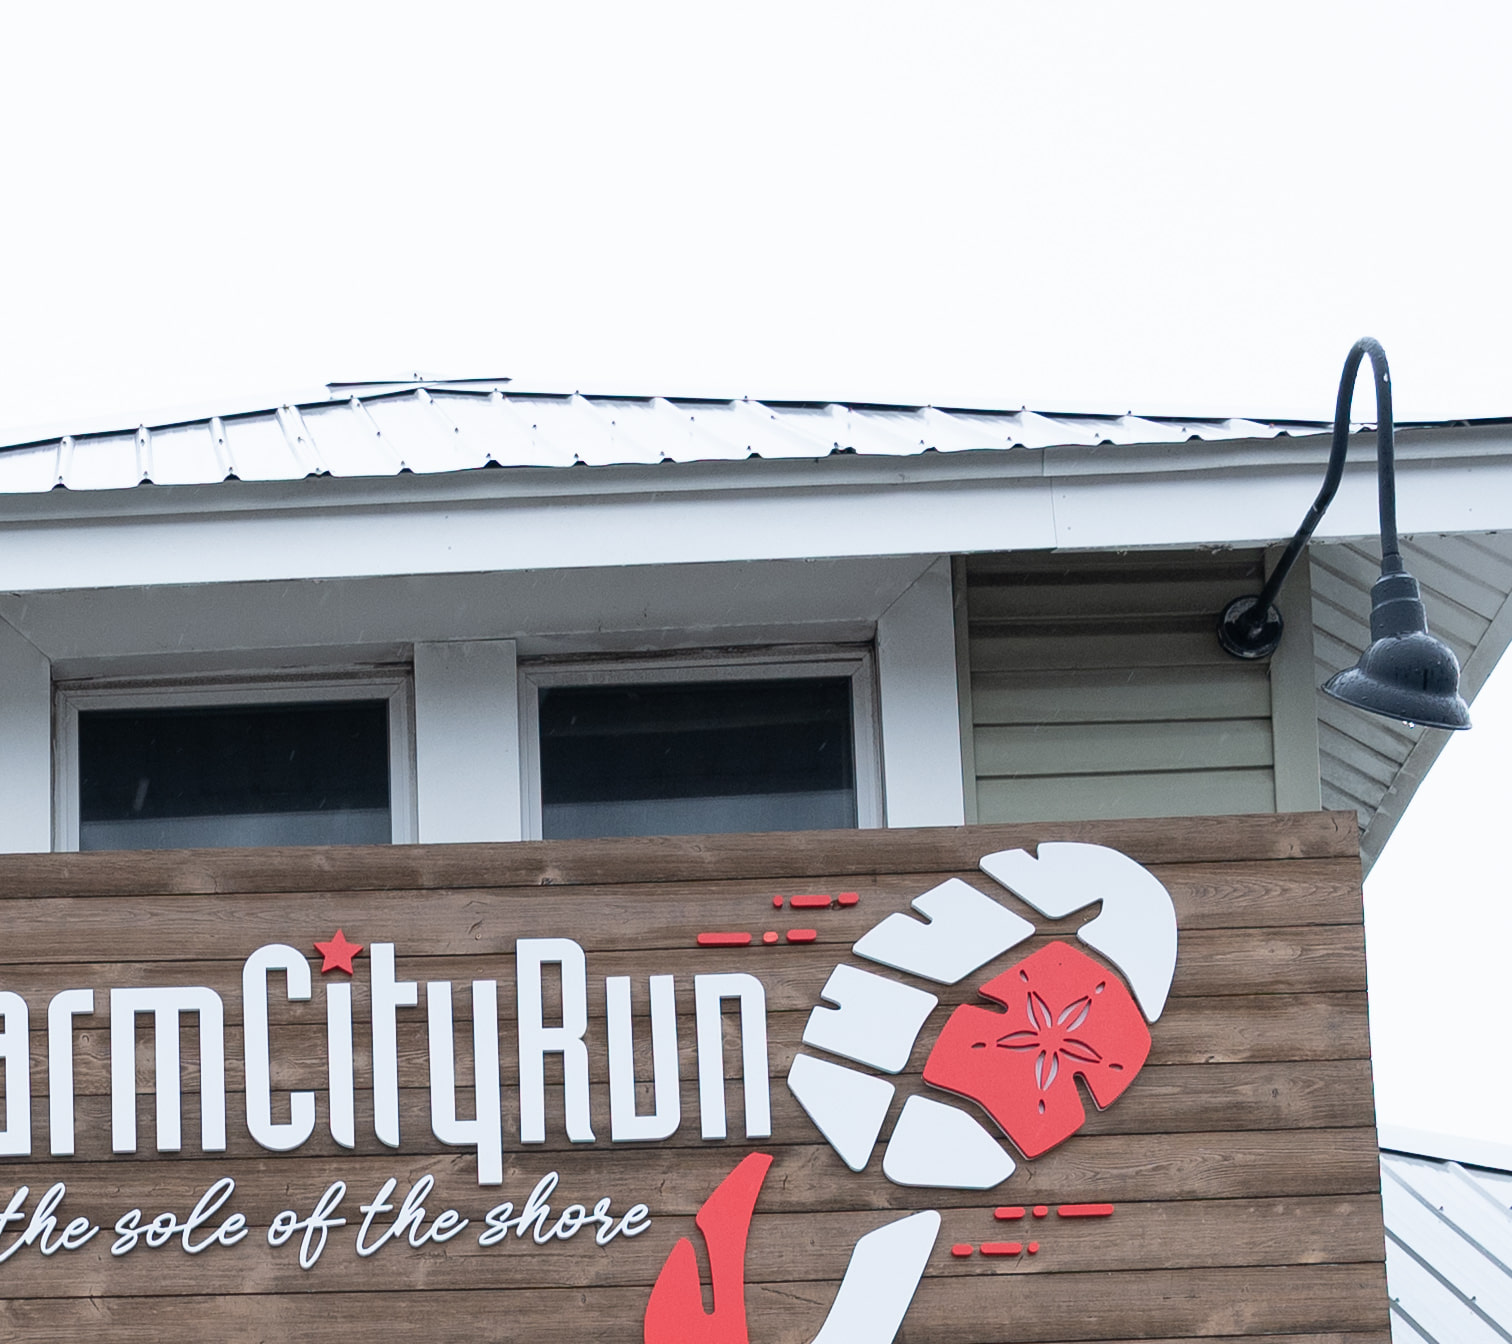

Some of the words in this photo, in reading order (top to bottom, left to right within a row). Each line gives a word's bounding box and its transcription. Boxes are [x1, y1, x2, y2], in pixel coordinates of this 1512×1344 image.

[110, 1176, 249, 1256] sole
[267, 1180, 347, 1269] of
[355, 1173, 469, 1257] the
[478, 1170, 652, 1246] shore
